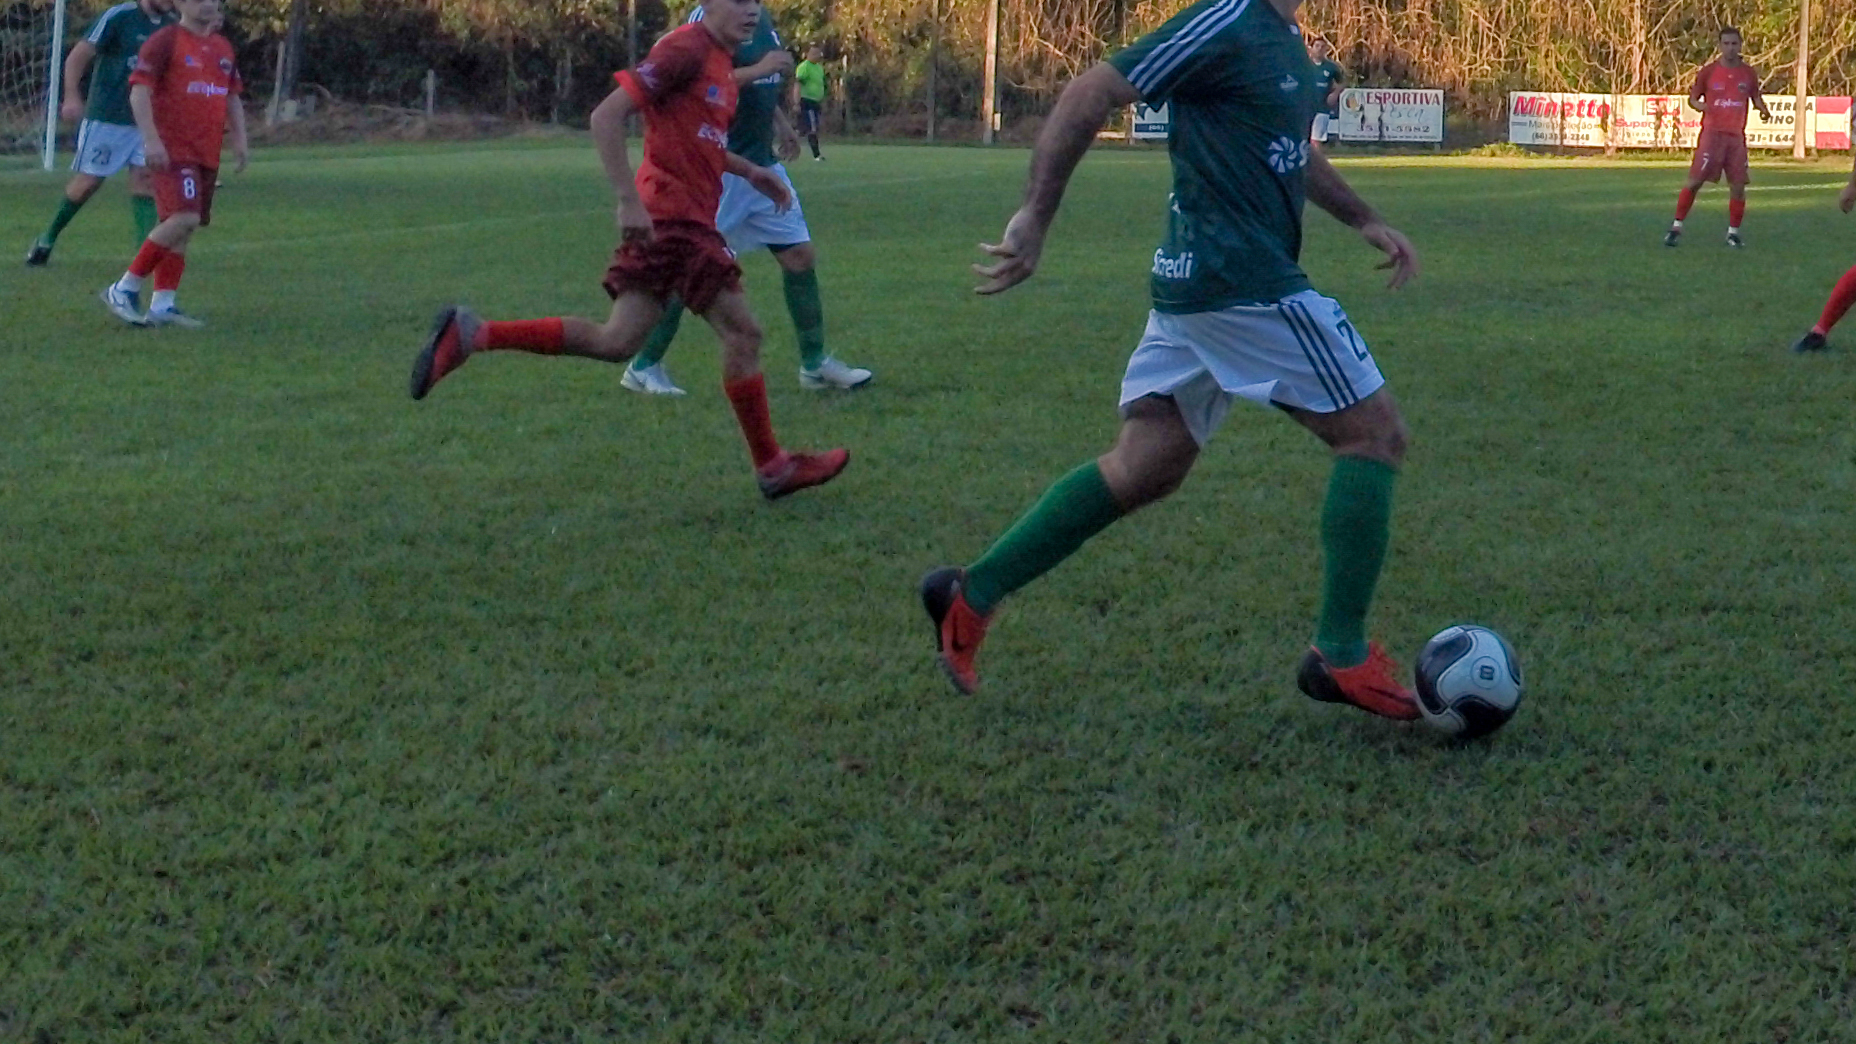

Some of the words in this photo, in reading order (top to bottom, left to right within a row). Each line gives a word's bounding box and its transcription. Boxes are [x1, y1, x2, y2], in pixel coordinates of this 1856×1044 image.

[1366, 92, 1441, 105] ESPORTIVA
[1513, 95, 1611, 118] Minetto
[182, 176, 197, 200] 8
